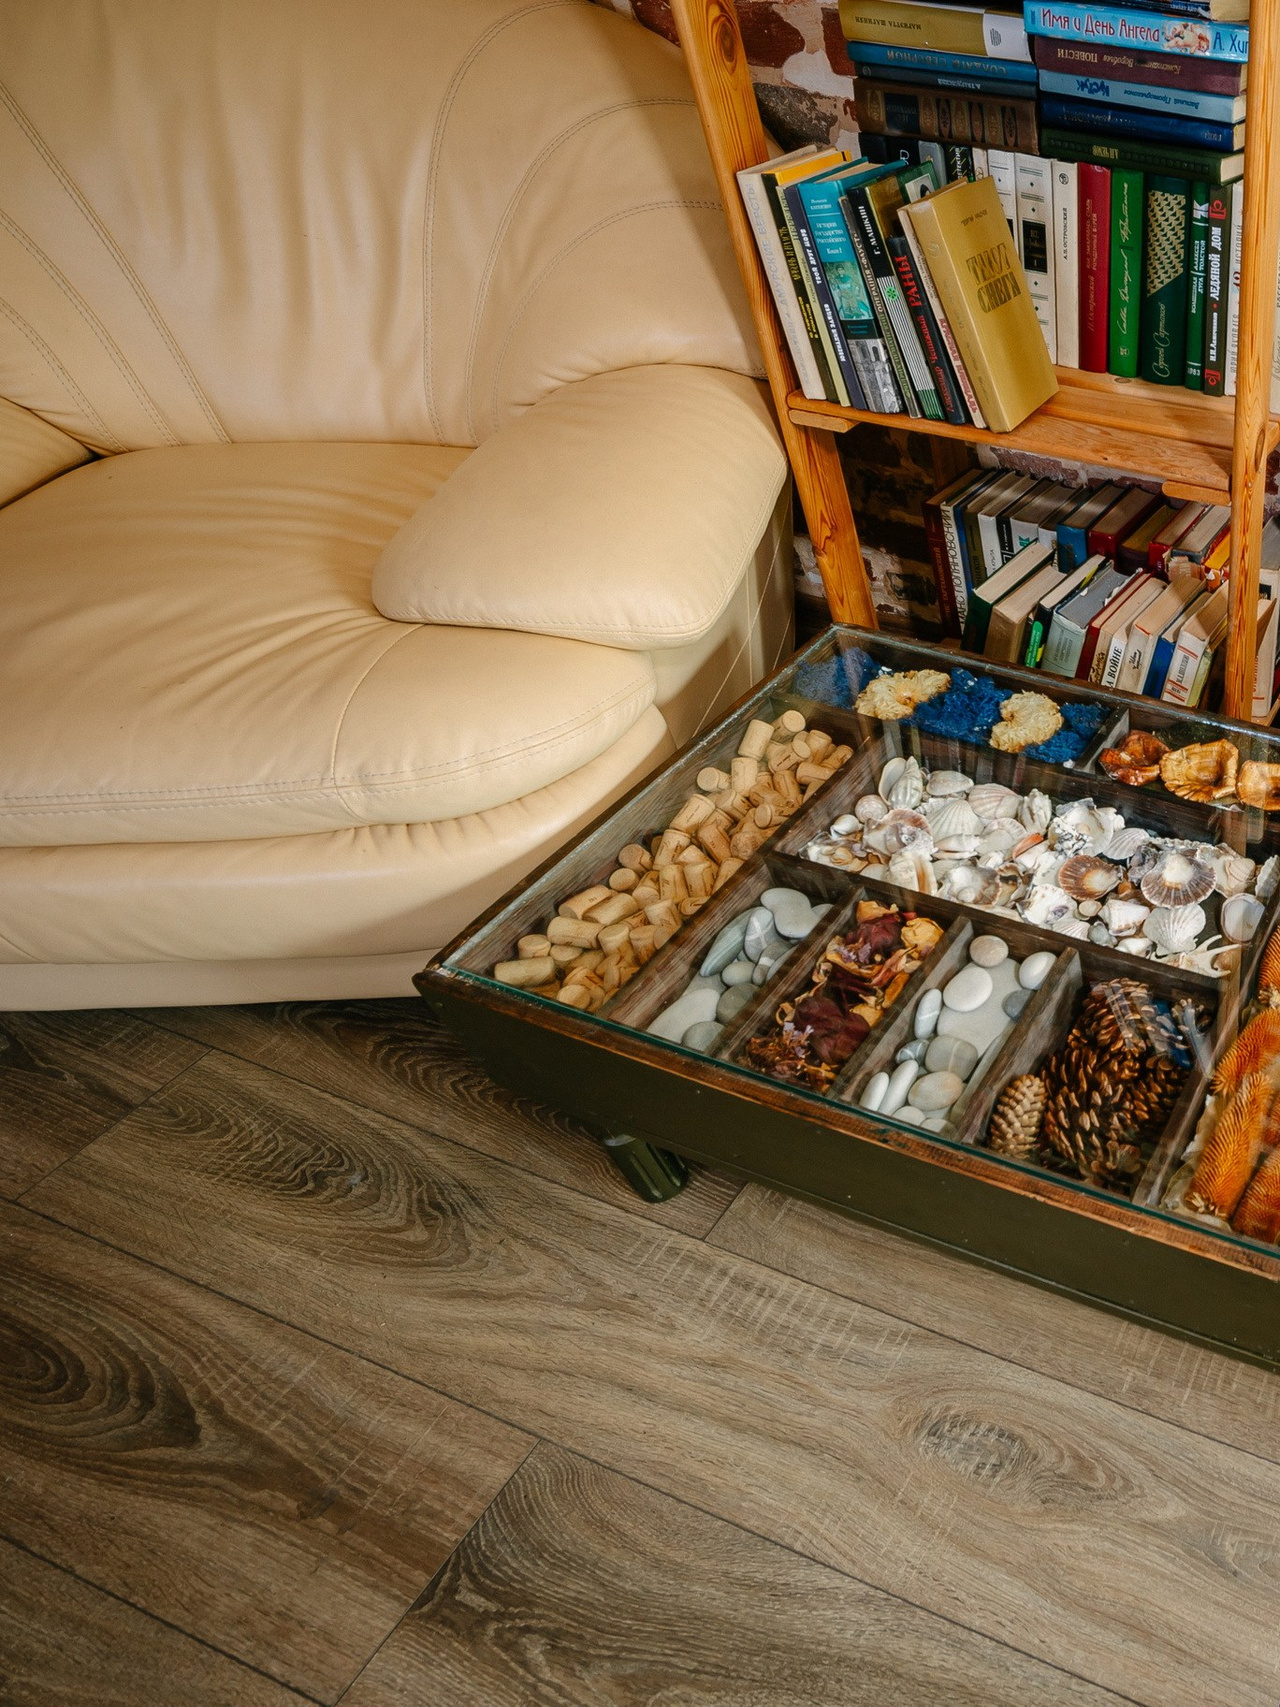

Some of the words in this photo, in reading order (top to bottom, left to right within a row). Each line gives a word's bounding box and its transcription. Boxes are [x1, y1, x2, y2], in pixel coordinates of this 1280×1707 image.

[1039, 7, 1072, 31] Имя
[1071, 17, 1082, 31] и
[1082, 13, 1117, 40] День
[1117, 19, 1161, 45] Ангела
[1055, 44, 1098, 65] ПОВЕСТИ
[798, 227, 812, 248] МОРЕ
[857, 206, 880, 247] МАШКИН
[1210, 225, 1223, 249] ДОМ
[805, 247, 816, 265] ДРУГ
[810, 265, 822, 284] ТВОЙ
[893, 252, 924, 308] РАНЫ
[1207, 253, 1222, 300] ЛЕДЯНОЙ
[864, 268, 884, 313] ОПЕРАЦИЯ
[1150, 346, 1172, 377] Сергей
[1105, 646, 1122, 678] ВОЙНЕ
